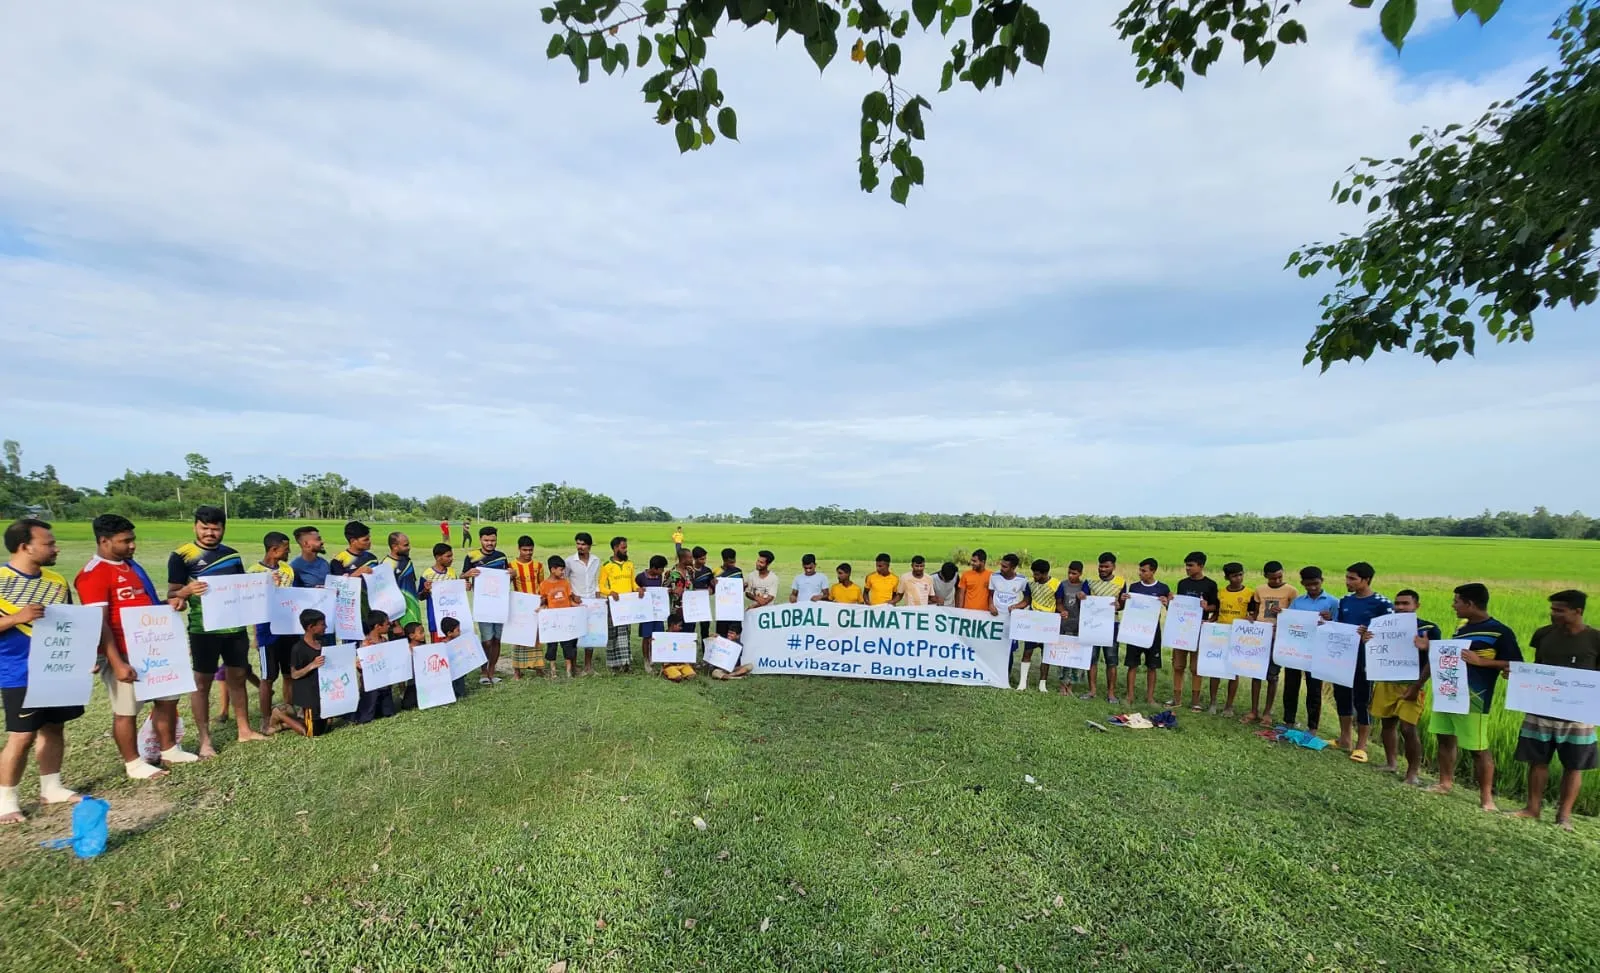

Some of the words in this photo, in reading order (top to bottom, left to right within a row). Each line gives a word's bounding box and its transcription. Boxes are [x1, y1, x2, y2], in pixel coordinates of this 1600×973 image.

[56, 621, 73, 633] WE
[758, 607, 830, 630] GLOBAL
[837, 608, 930, 631] CLIMATE
[935, 614, 1004, 640] STRIKE
[44, 636, 73, 648] CANT
[787, 634, 976, 662] #PeopleNotProfit
[50, 650, 72, 660] EAT
[1369, 644, 1389, 655] FOR
[43, 663, 76, 673] MONEY
